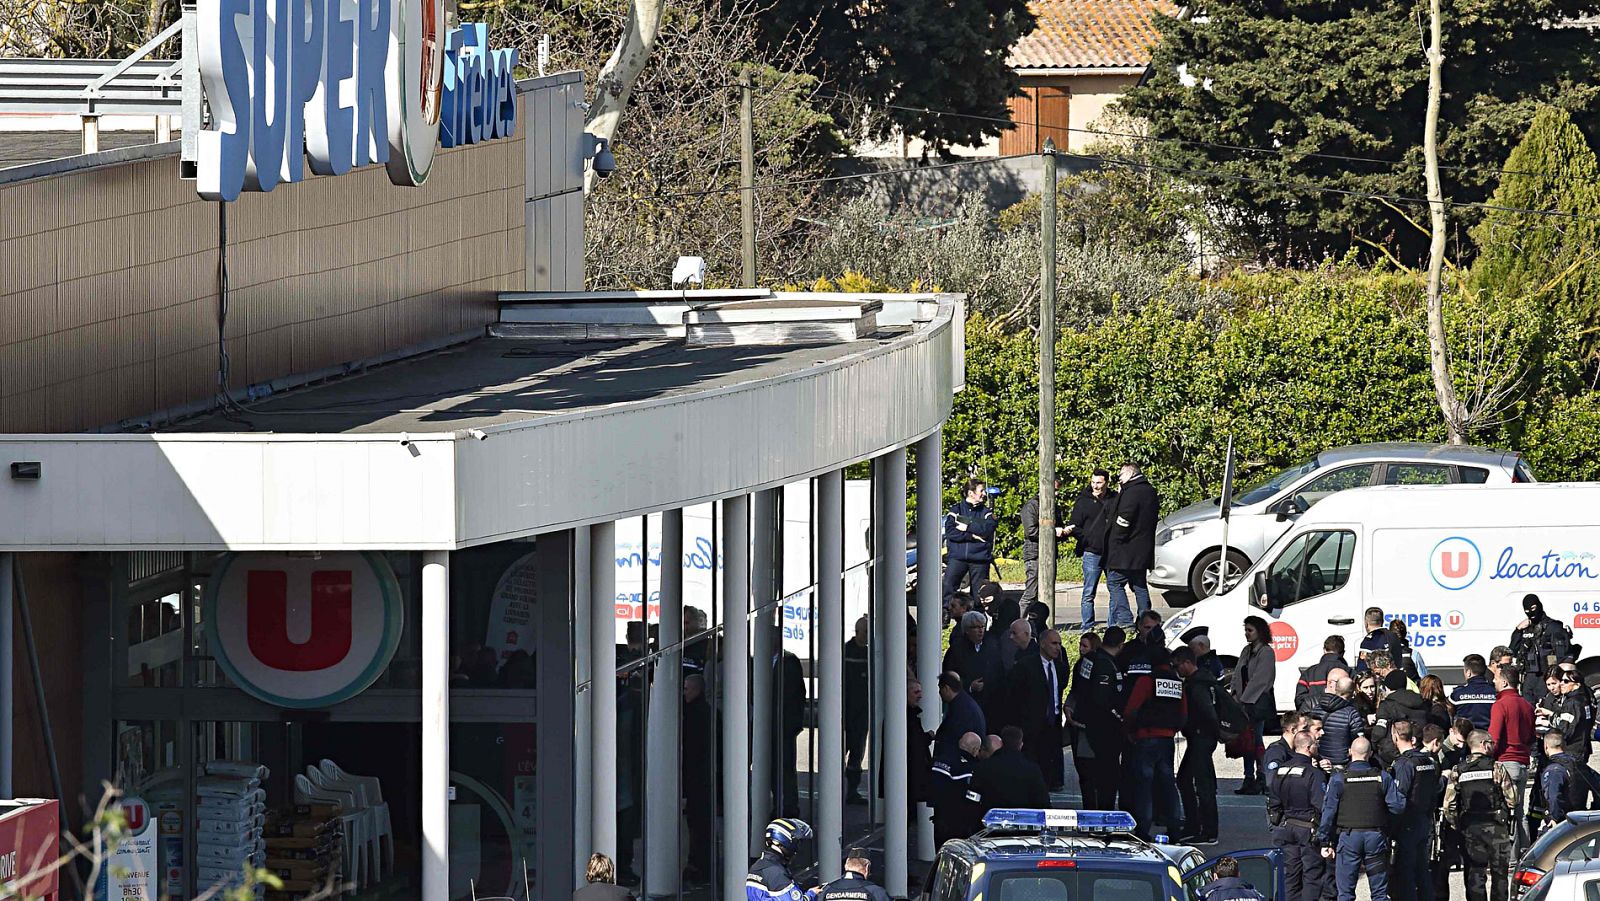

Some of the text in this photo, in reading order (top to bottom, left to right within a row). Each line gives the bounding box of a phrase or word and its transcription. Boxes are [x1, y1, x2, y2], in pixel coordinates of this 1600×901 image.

[215, 0, 391, 202] SUPER
[1441, 546, 1599, 579] U location
[1573, 602, 1589, 612] 04
[247, 569, 353, 672] U
[1449, 615, 1460, 625] U
[1407, 631, 1447, 647] èbes
[1157, 681, 1182, 691] POLICE
[124, 804, 143, 829] U
[123, 887, 142, 896] 8h30
[825, 892, 868, 900] GENDARMERIE
